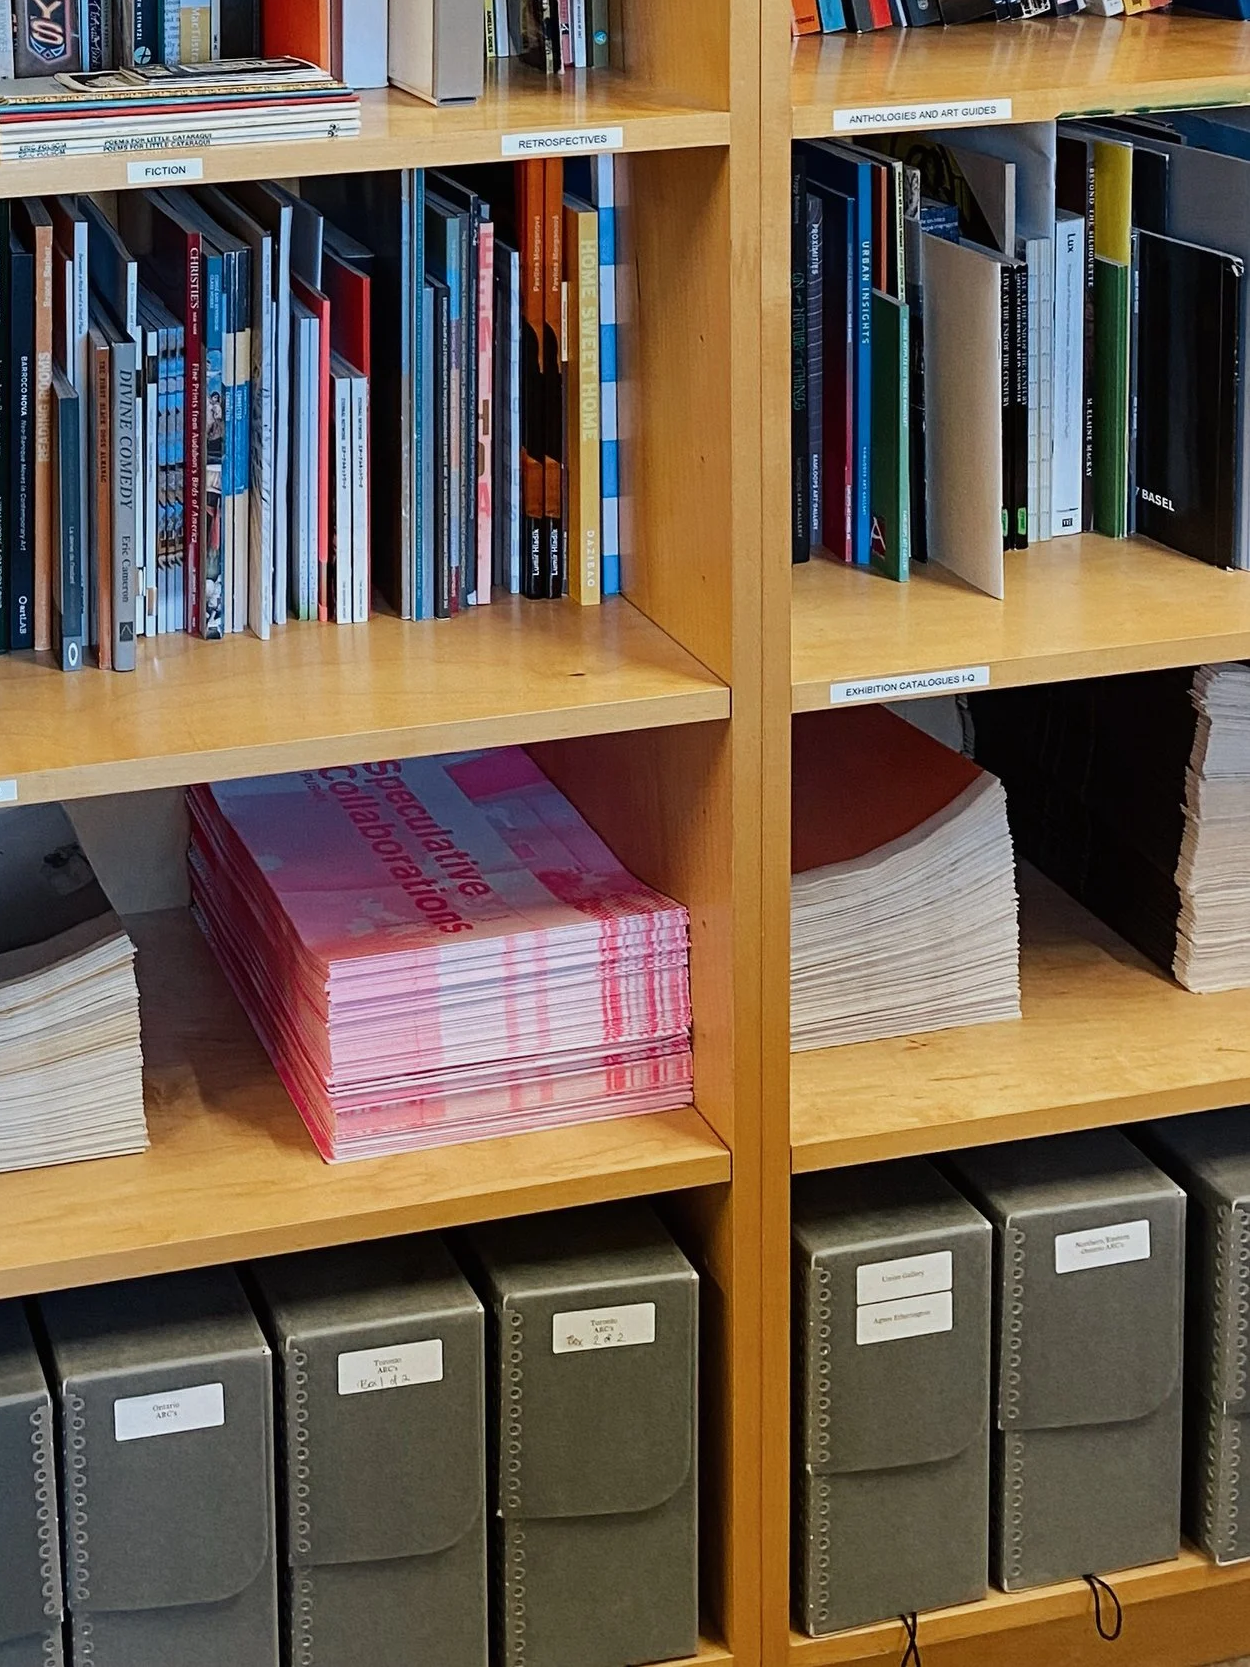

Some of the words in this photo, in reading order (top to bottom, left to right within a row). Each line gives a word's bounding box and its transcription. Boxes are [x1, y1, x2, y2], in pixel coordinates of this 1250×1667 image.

[850, 109, 916, 124] ANTHOLOGIES
[919, 108, 939, 120] AND
[941, 107, 958, 118] ART
[960, 104, 996, 116] GUIDES
[519, 135, 607, 149] RETROSPECTIVES
[145, 166, 186, 176] FICTION
[811, 222, 820, 275] PROXIMITIES
[1067, 233, 1076, 253] Lux
[861, 241, 870, 281] URBAN
[862, 287, 870, 344] INSIGHTS
[119, 370, 132, 424] DIVINE
[120, 436, 133, 509] COMEDY
[1141, 487, 1175, 511] BASEL
[122, 535, 130, 555] Eric
[121, 559, 129, 603] Cameron
[846, 683, 897, 697] EXHIBITION
[899, 675, 961, 690] CATALOGUES
[962, 673, 975, 684] I-Q
[152, 1402, 180, 1412] Ontario
